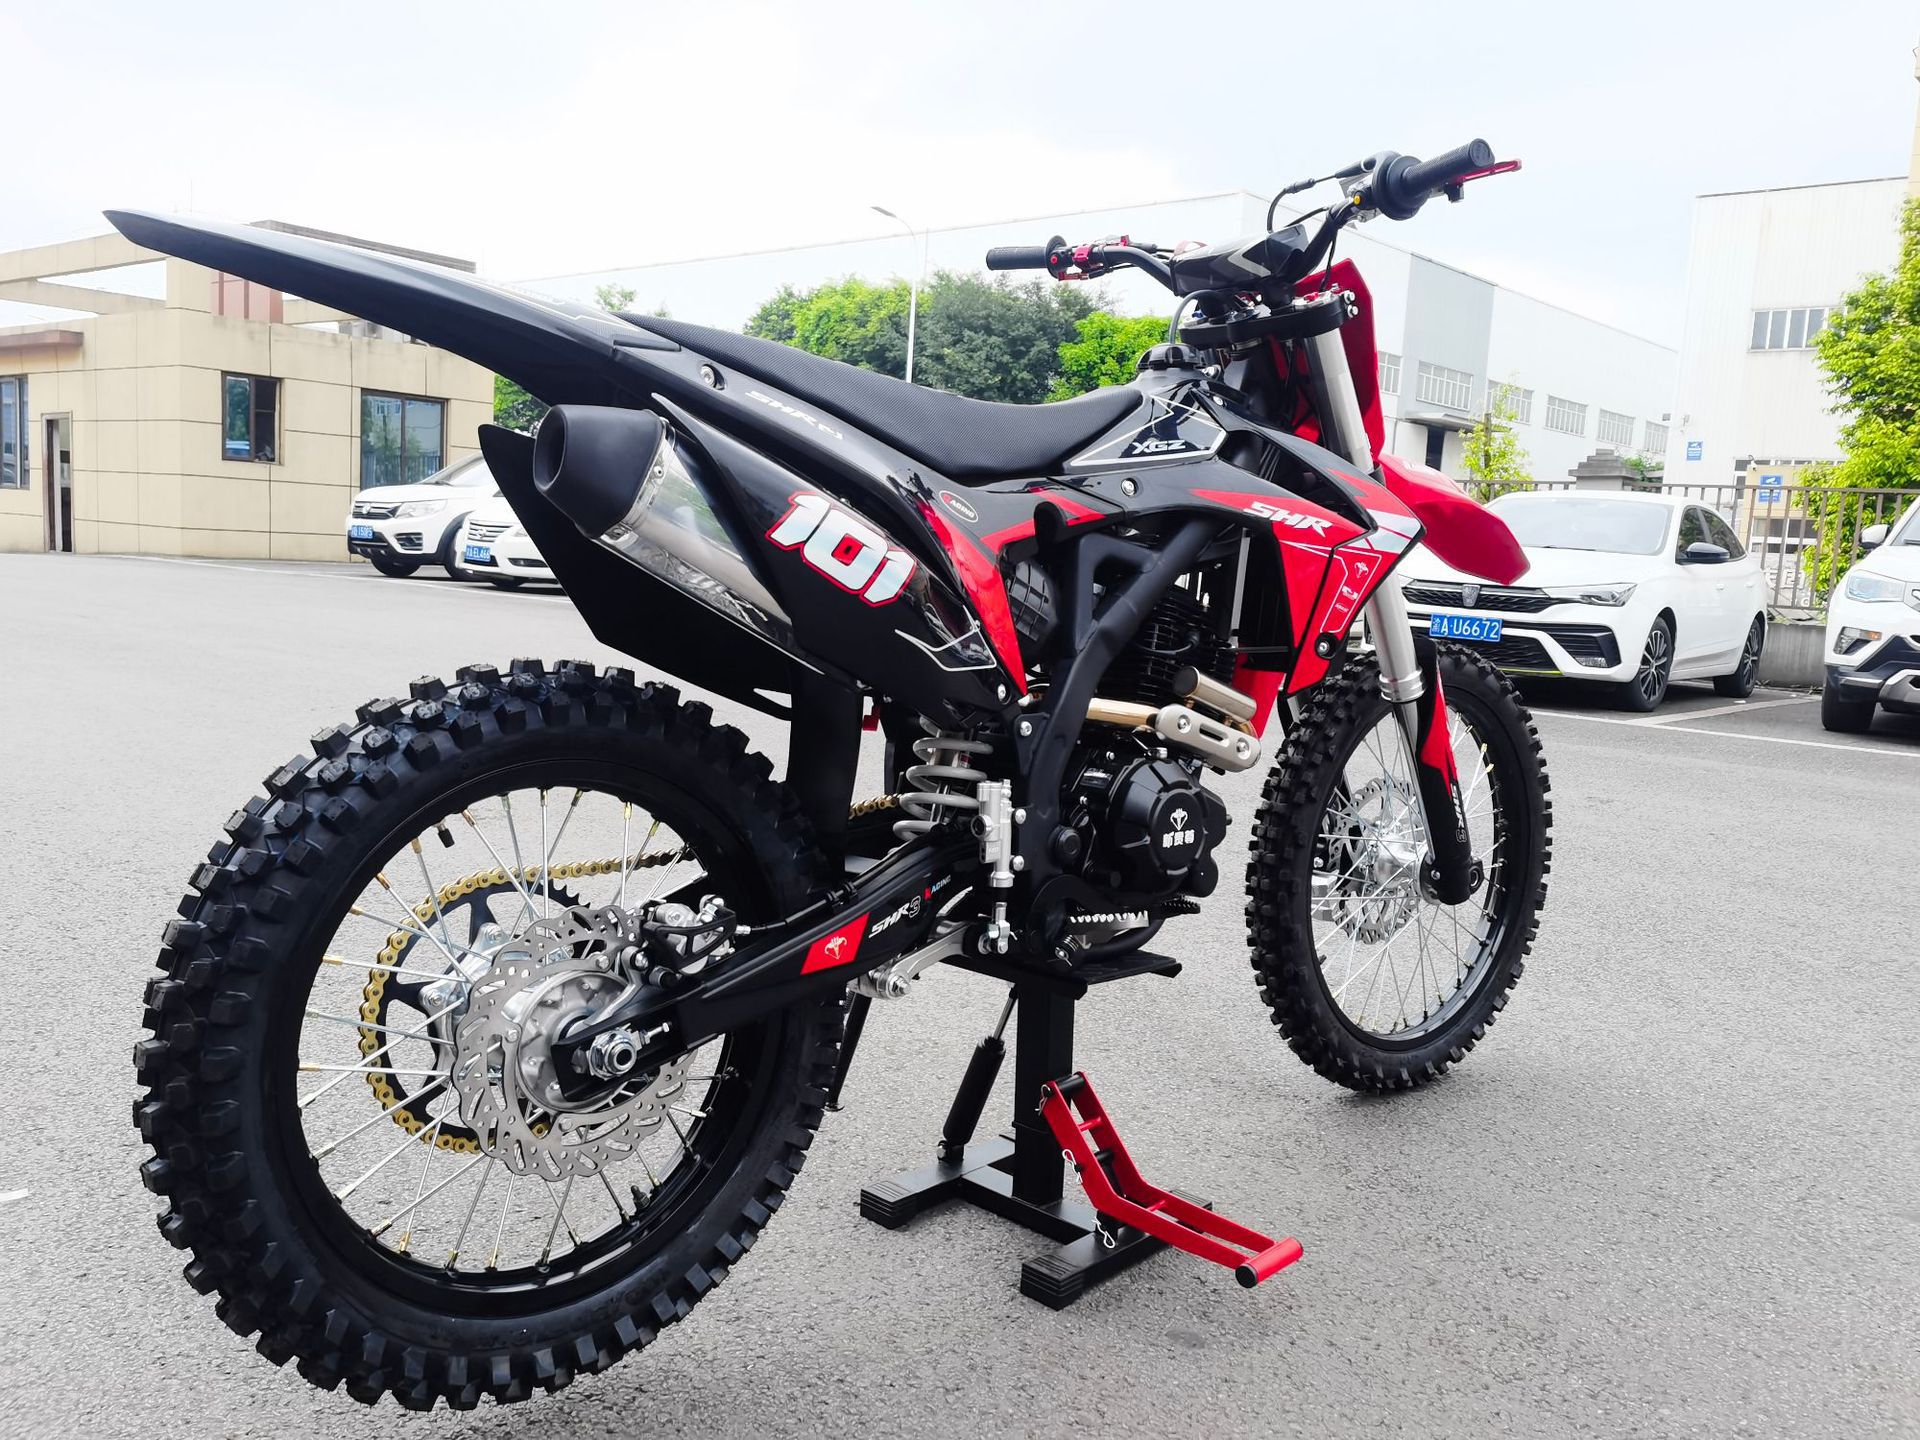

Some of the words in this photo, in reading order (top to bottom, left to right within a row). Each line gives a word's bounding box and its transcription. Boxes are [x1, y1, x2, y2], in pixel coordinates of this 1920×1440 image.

[1132, 440, 1186, 455] XGZ
[1243, 501, 1334, 538] SHR
[768, 493, 917, 605] 101
